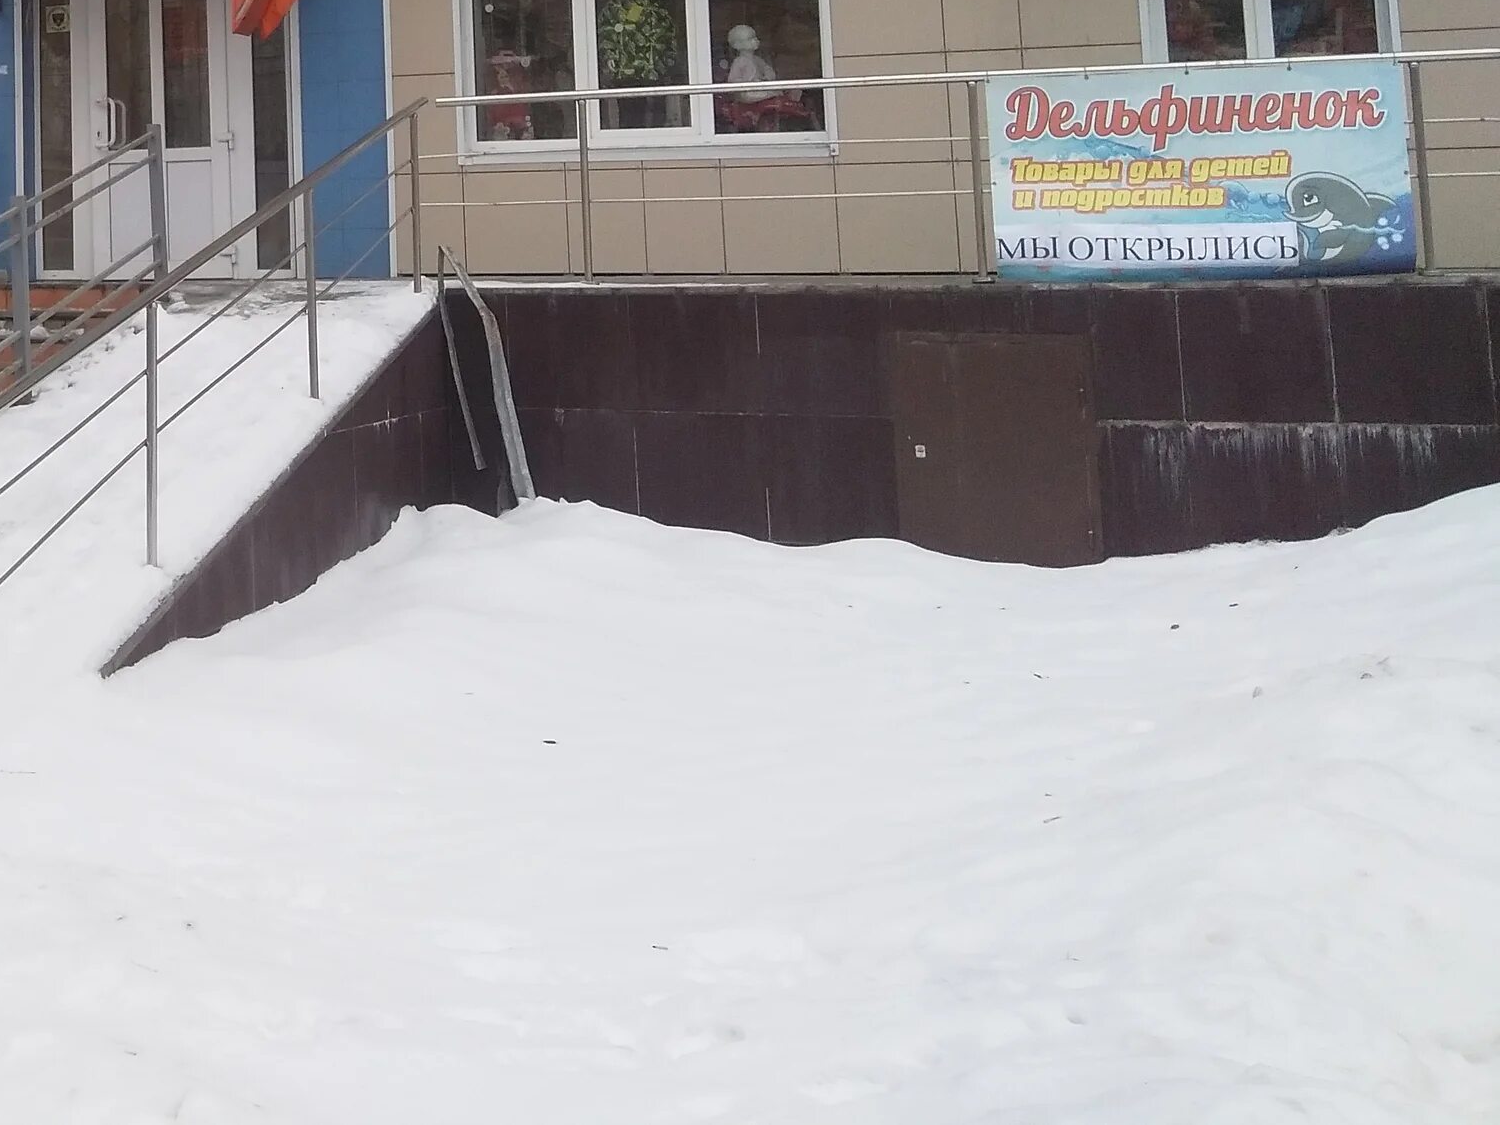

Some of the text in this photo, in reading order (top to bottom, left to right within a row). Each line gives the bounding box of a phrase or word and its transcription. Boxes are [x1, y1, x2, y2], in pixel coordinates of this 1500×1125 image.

[1005, 84, 1385, 152] Дельфиненок
[1012, 152, 1290, 185] Товары для детей
[1014, 186, 1226, 212] и подростков
[998, 235, 1298, 261] МЫ ОТКРЫЛИСЬ
